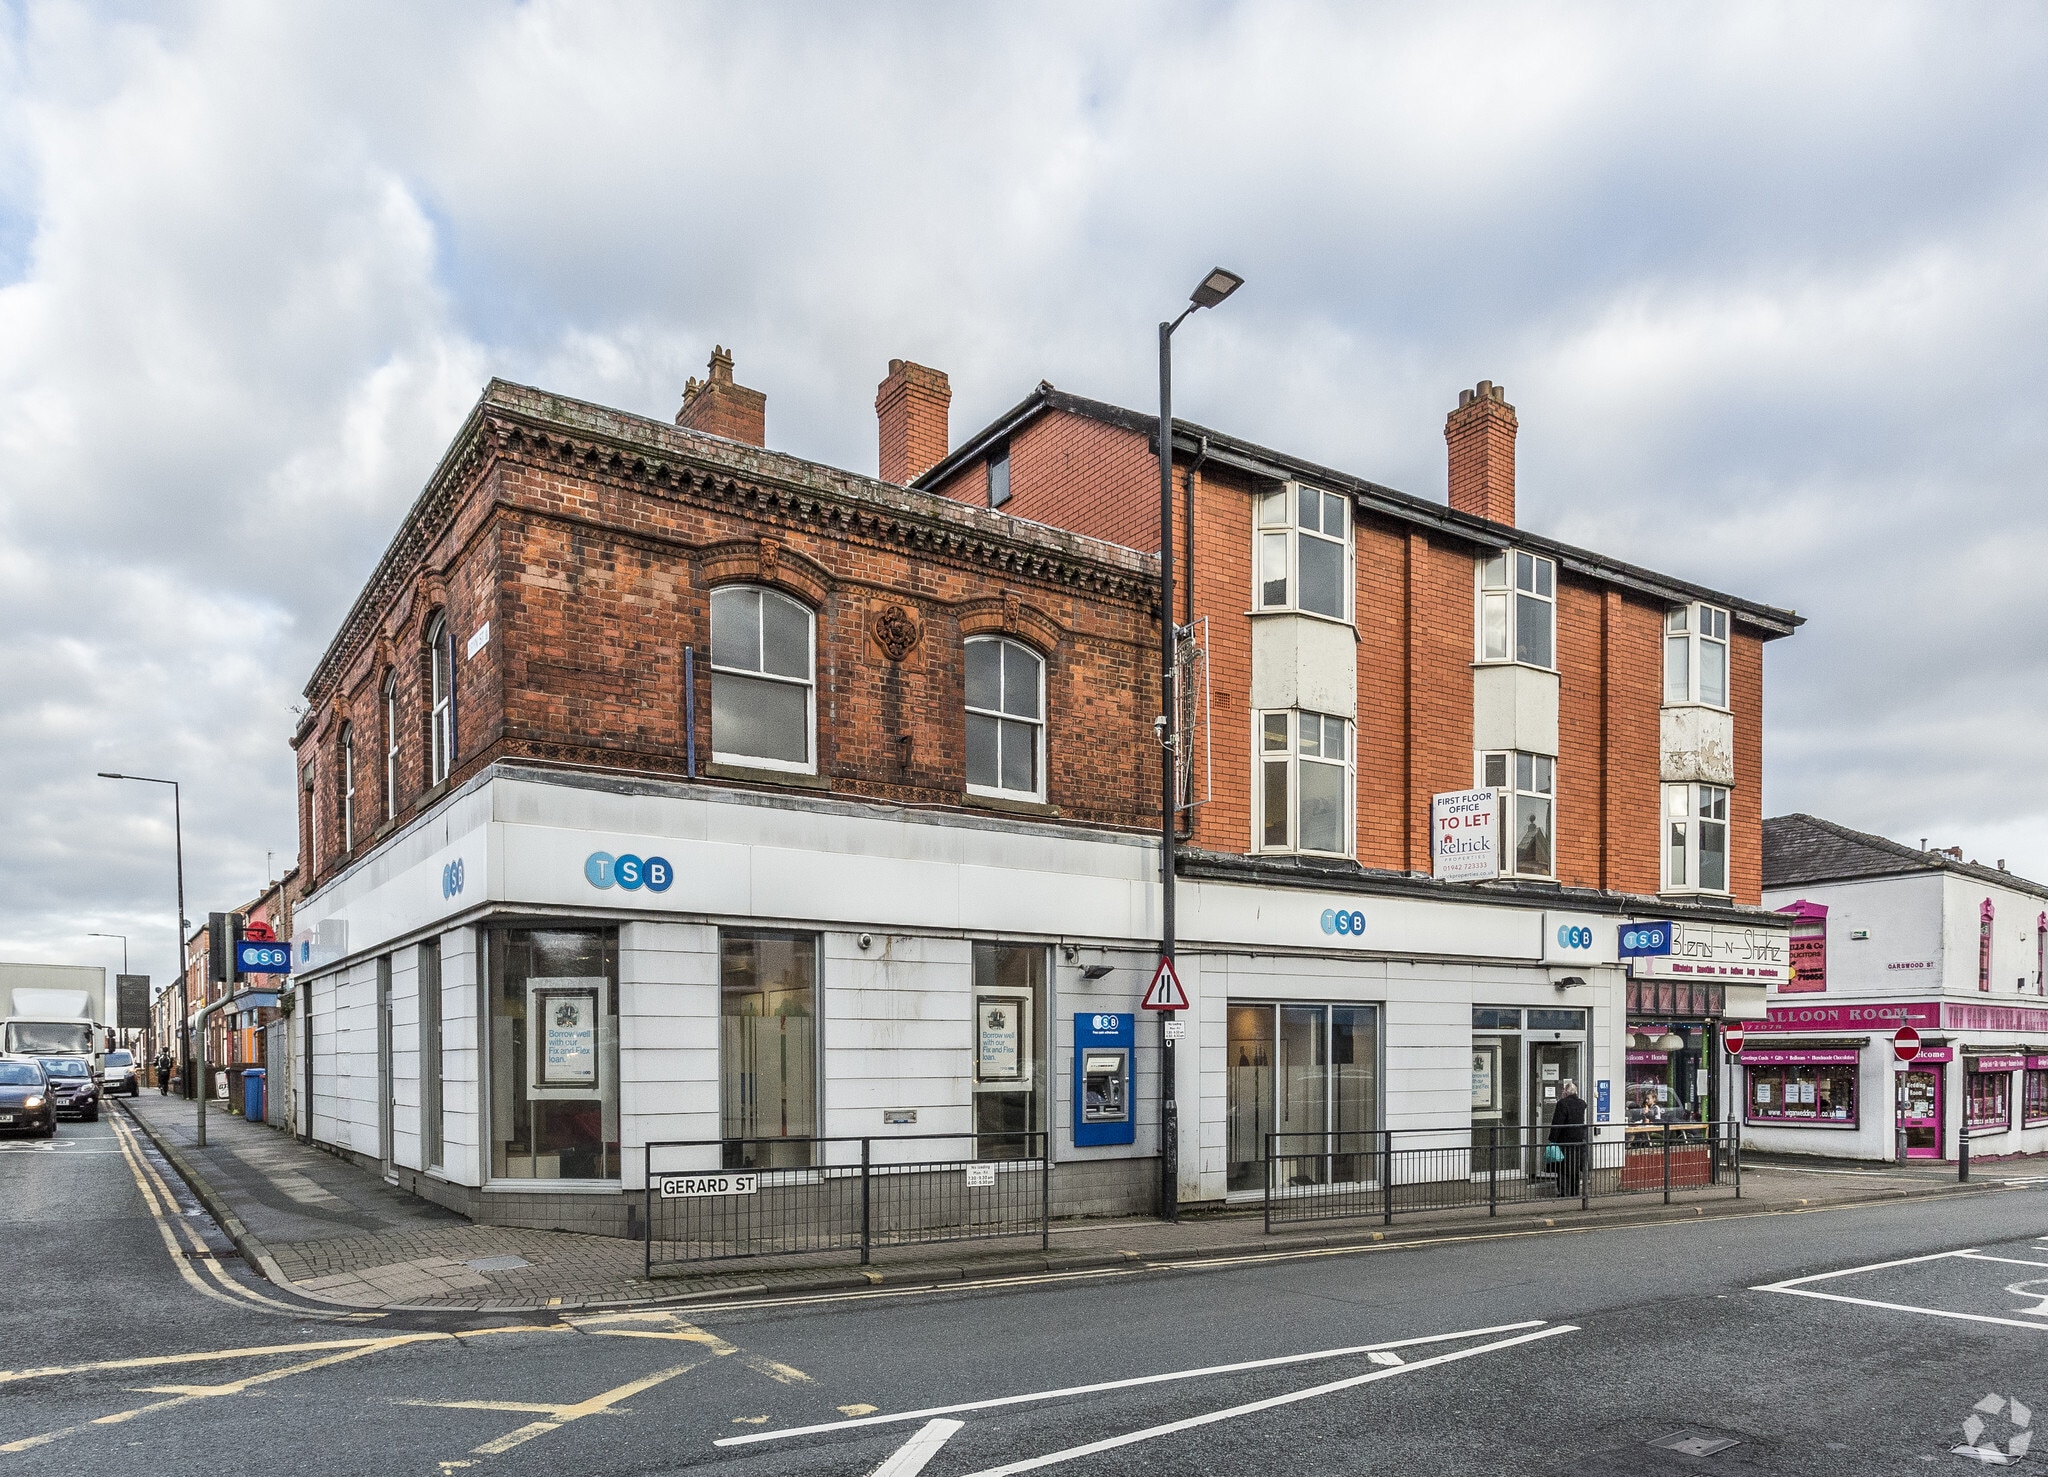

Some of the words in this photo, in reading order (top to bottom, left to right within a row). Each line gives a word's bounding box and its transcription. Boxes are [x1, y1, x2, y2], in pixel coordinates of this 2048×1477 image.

[1437, 796, 1460, 806] FIRST
[1462, 792, 1492, 803] FLOOR
[1448, 803, 1480, 814] OFFICE
[1439, 817, 1460, 830] TO
[1465, 813, 1491, 827] LET
[1440, 835, 1491, 855] kelrick
[1444, 854, 1486, 862] PROPERTIES
[594, 857, 668, 887] TSB
[1443, 864, 1463, 872] 01942
[1464, 861, 1488, 870] 723333
[1324, 913, 1363, 932] TSB
[1560, 930, 1591, 946] TSB
[1627, 932, 1661, 946] TSB
[247, 951, 284, 963] TSB
[1764, 1009, 1839, 1023] ALLOON
[1846, 1007, 1909, 1020] ROOM
[548, 1030, 573, 1038] Borrow
[576, 1030, 591, 1038] well
[548, 1038, 563, 1046] with
[560, 1047, 574, 1055] and
[575, 1046, 590, 1055] Flex
[548, 1055, 566, 1063] loan.
[663, 1178, 729, 1195] GERARD
[735, 1177, 754, 1191] ST
